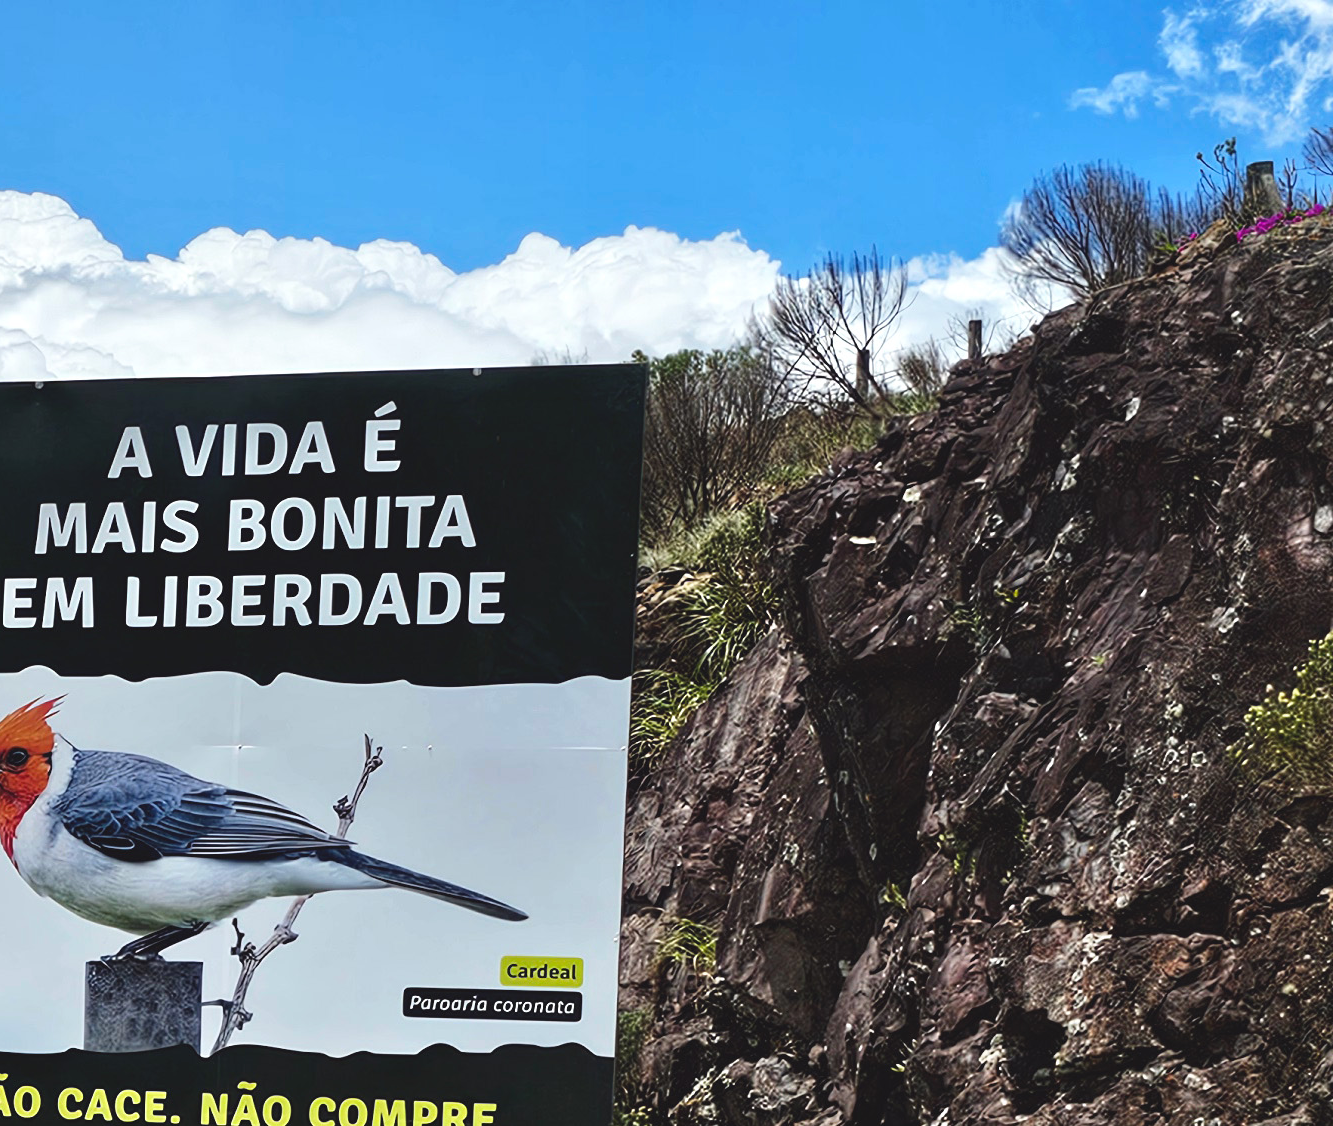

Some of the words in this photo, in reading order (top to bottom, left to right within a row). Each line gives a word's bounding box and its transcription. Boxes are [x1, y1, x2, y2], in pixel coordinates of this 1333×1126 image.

[108, 426, 152, 478] A
[176, 421, 333, 476] VIDA
[365, 401, 401, 472] É
[36, 501, 200, 554] MAIS
[228, 494, 476, 551] BONITA
[3, 577, 94, 628] EM
[125, 571, 506, 627] LIBERDADE
[507, 964, 576, 979] Cardeal
[410, 996, 487, 1011] Paroaria
[494, 1001, 575, 1014] coronata
[57, 1087, 180, 1125] CACE.
